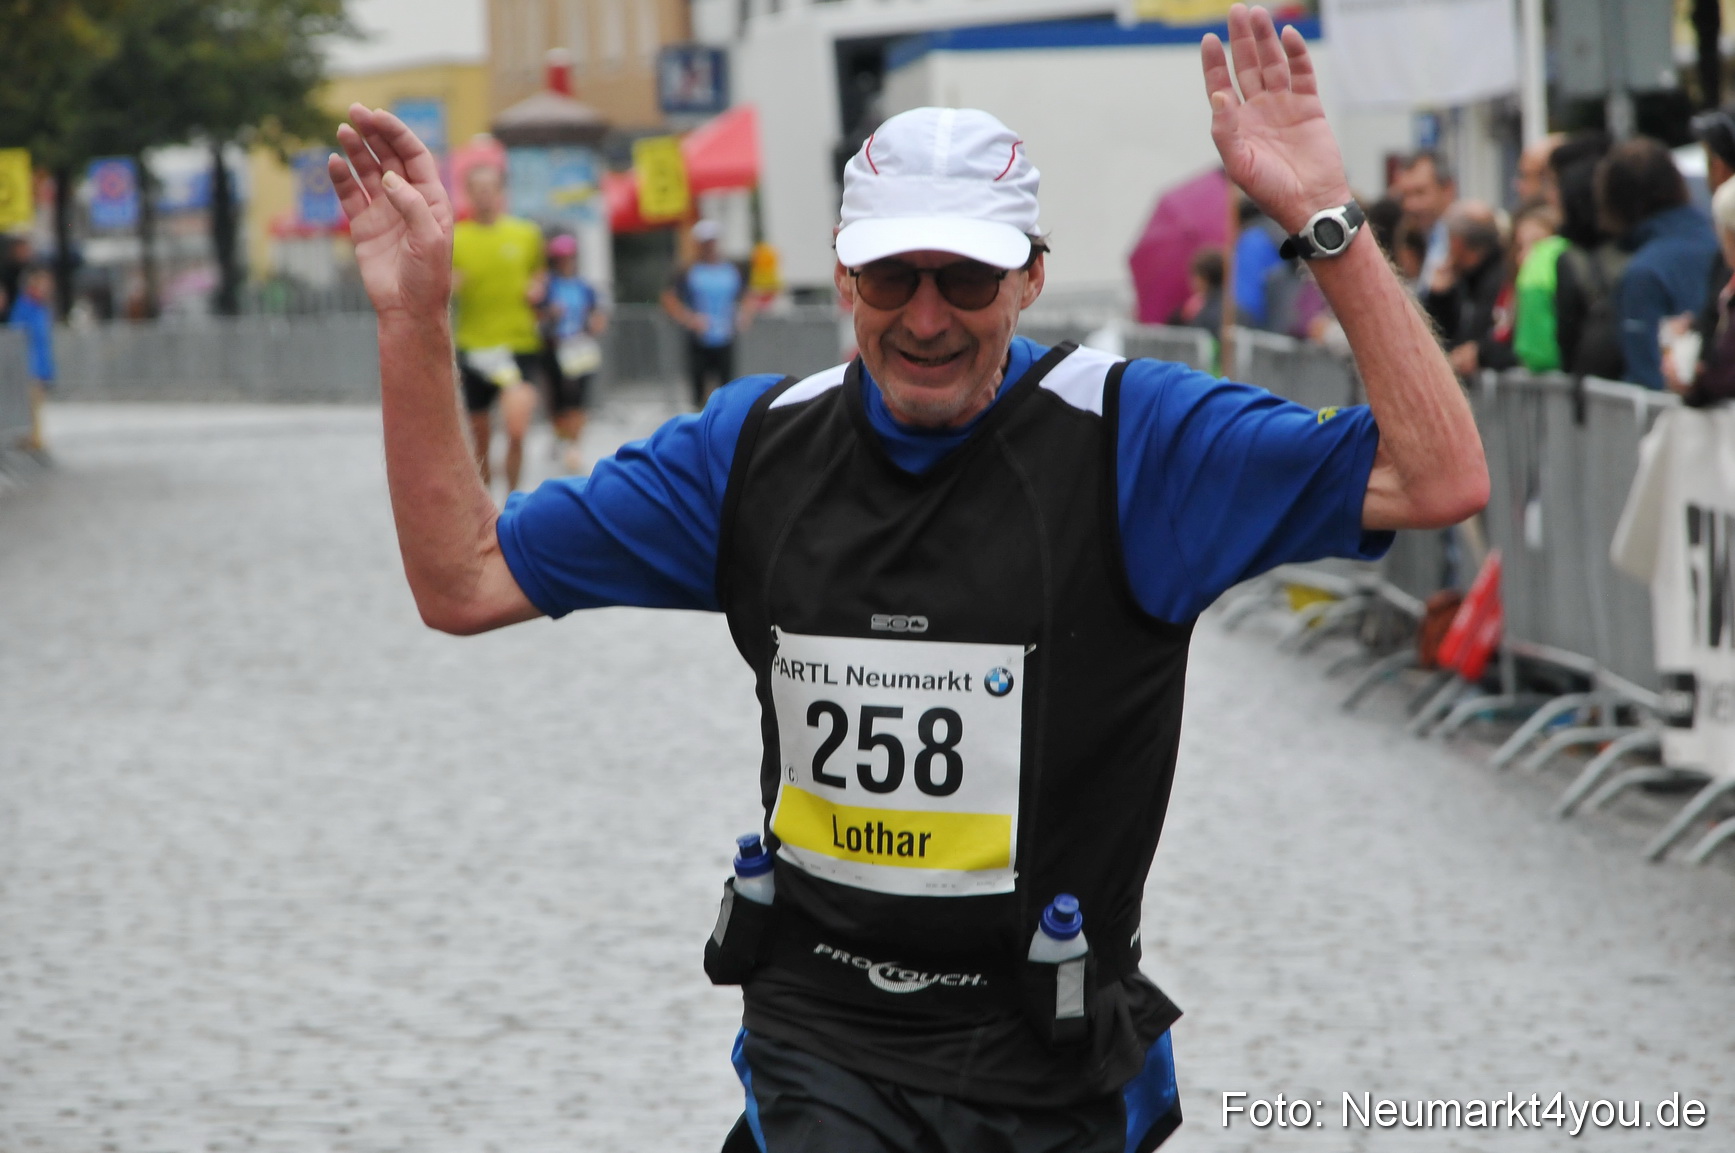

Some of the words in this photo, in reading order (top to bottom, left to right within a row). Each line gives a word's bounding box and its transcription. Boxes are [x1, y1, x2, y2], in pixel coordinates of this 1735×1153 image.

[774, 653, 838, 685] PARTL
[846, 665, 973, 692] Neumarkt
[806, 700, 964, 797] 258
[832, 814, 931, 859] Lothar
[813, 943, 873, 970] PRO
[885, 966, 982, 987] TOUCH
